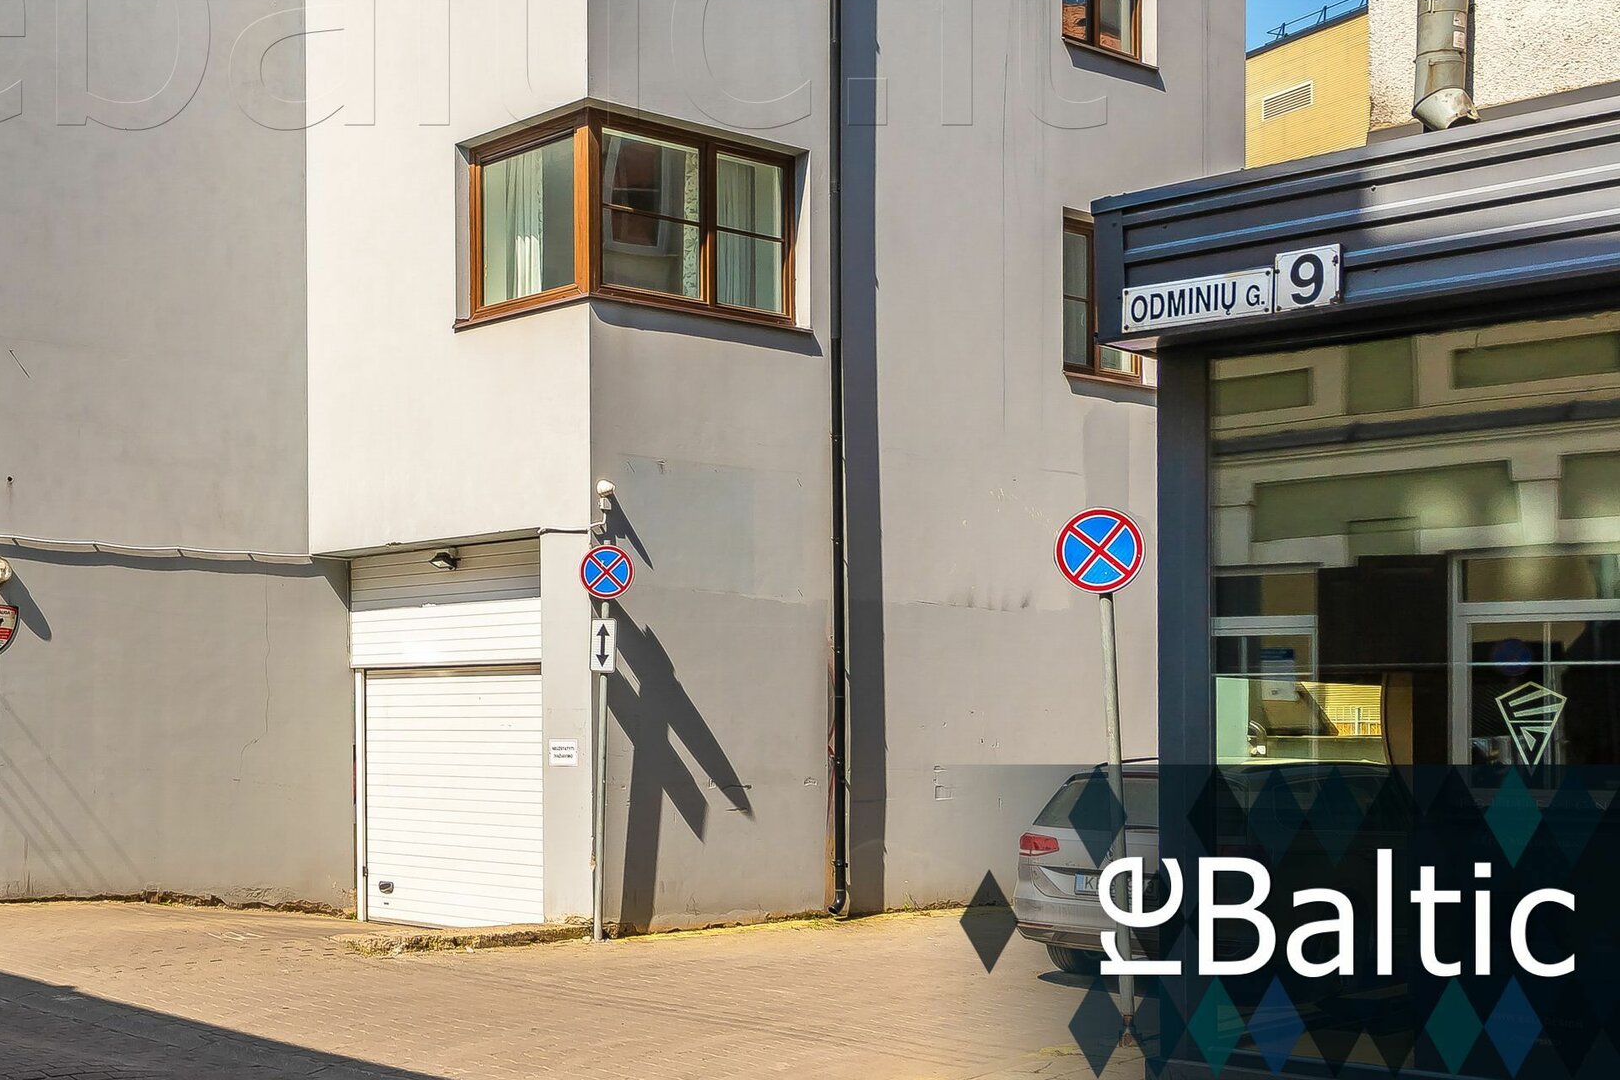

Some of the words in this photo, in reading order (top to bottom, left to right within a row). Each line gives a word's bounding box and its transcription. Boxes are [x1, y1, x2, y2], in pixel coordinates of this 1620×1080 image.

[1130, 281, 1237, 323] ODMINIŲ
[1246, 284, 1266, 307] G.
[1289, 253, 1325, 305] 9
